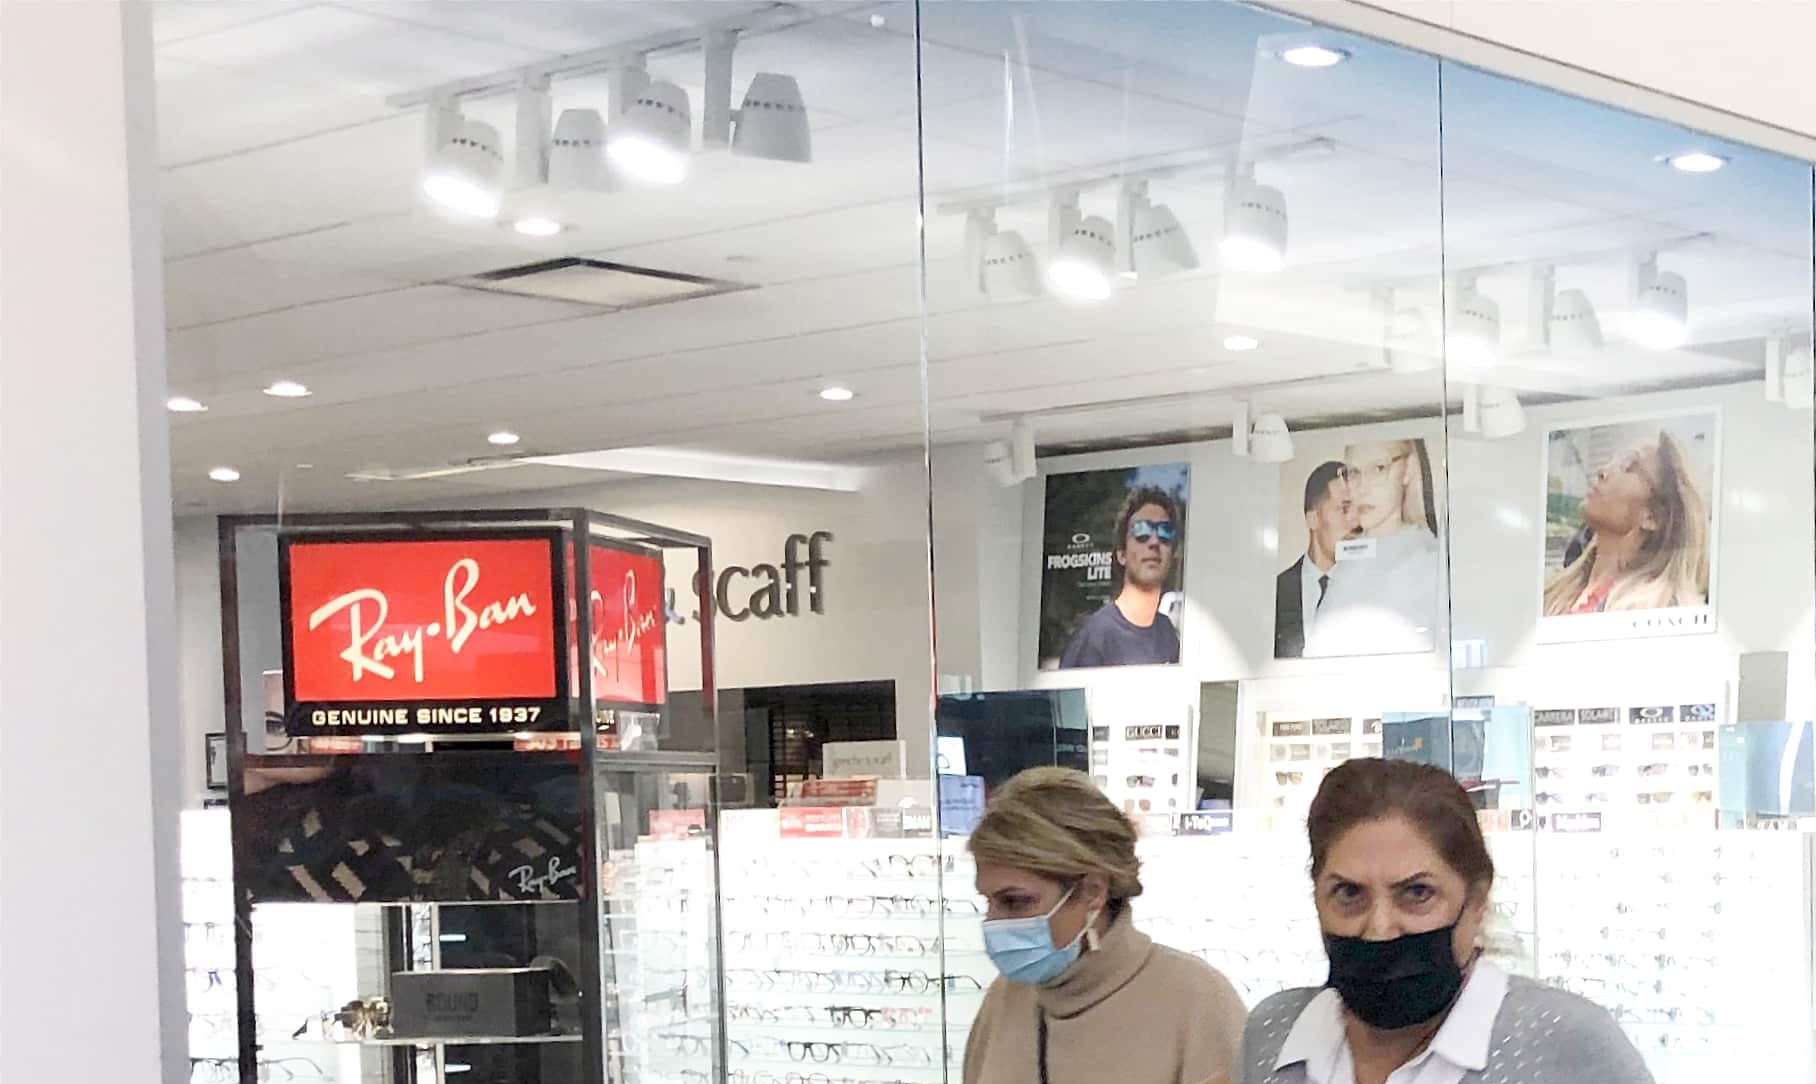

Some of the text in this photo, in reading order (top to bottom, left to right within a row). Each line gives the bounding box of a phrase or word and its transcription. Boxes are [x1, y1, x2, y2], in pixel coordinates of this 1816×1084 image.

[1087, 566, 1112, 580] LITE
[312, 706, 542, 726] GENUINE SINCE 1937
